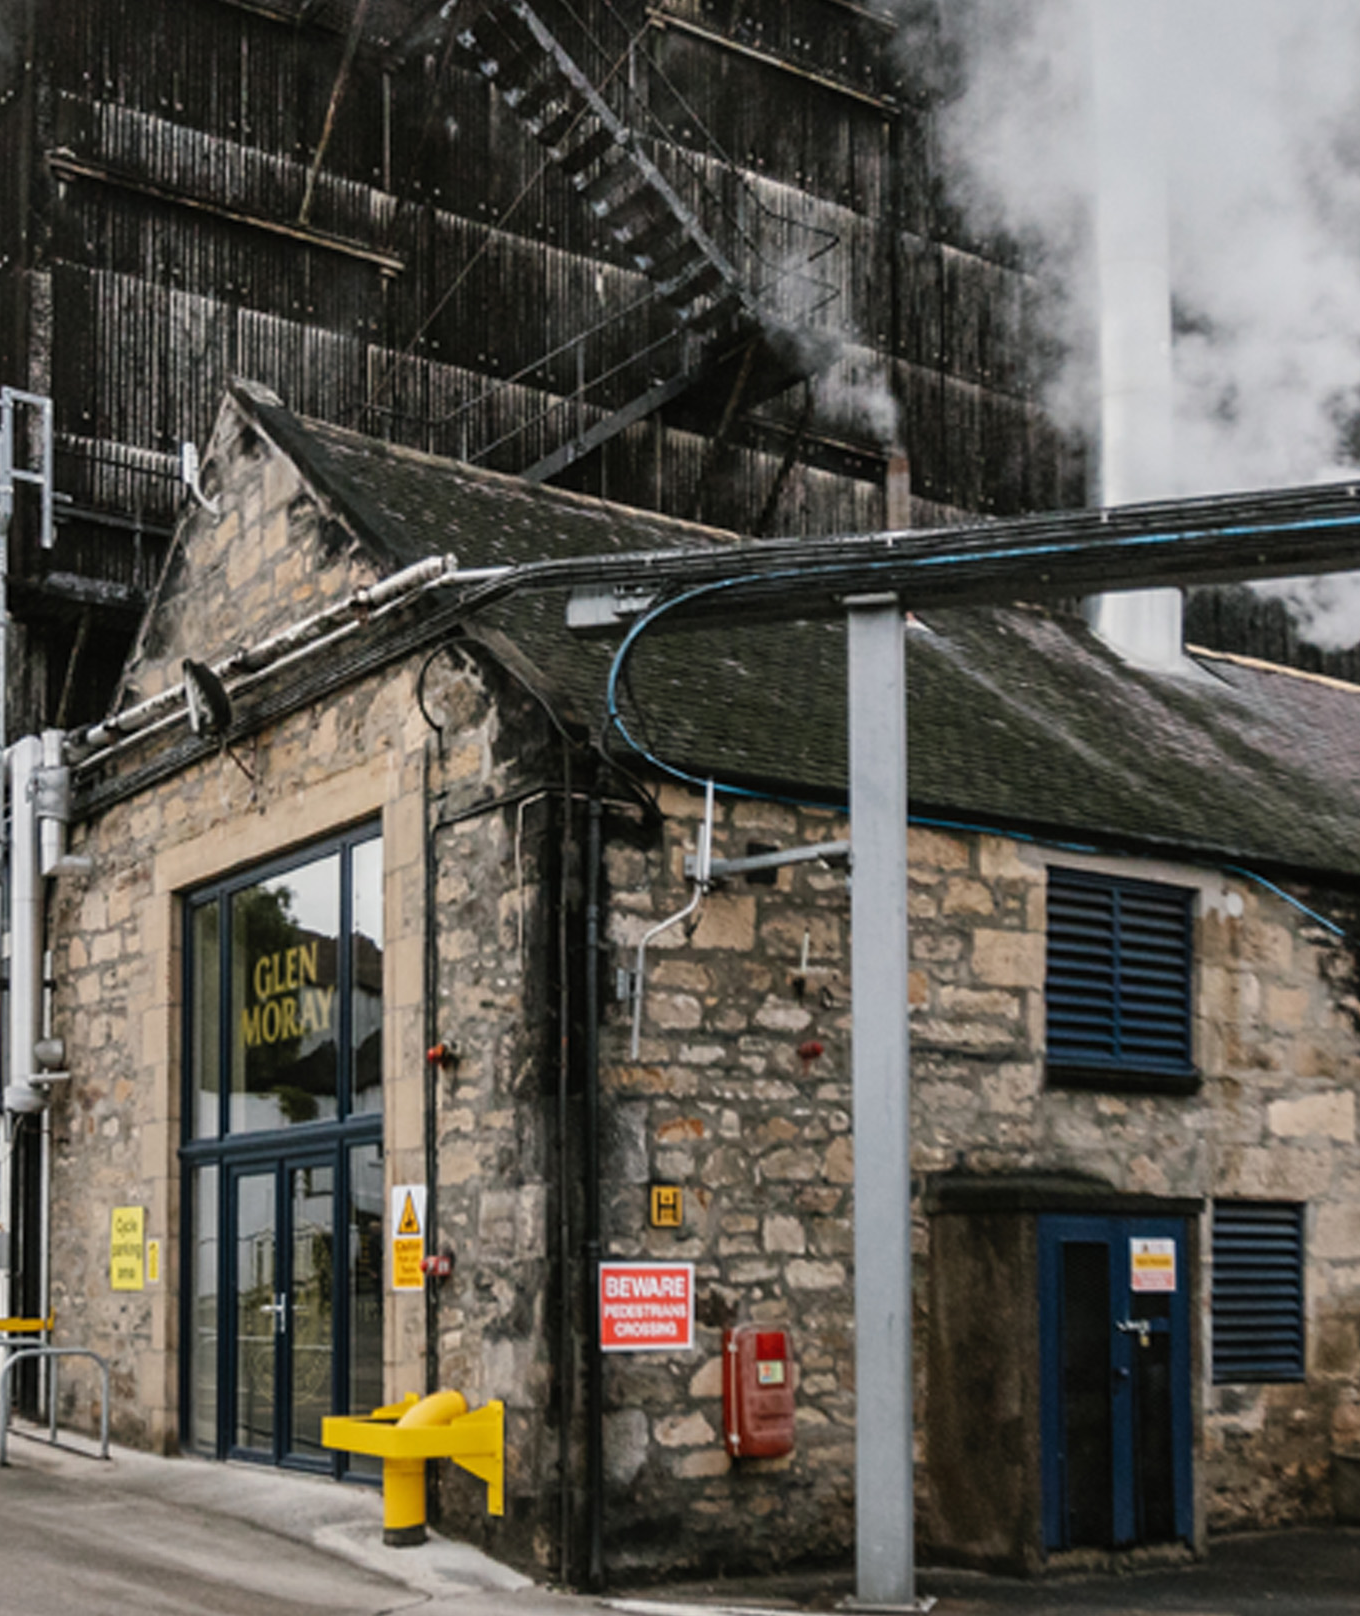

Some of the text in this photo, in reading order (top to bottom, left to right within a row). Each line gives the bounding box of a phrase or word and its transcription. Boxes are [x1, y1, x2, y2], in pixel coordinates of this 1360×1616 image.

[253, 940, 318, 1001] GLEN
[240, 984, 335, 1048] MORAY
[605, 1275, 686, 1298] BEWARE
[604, 1303, 686, 1320] PEDESTRIANS
[613, 1320, 678, 1338] CROSSING
